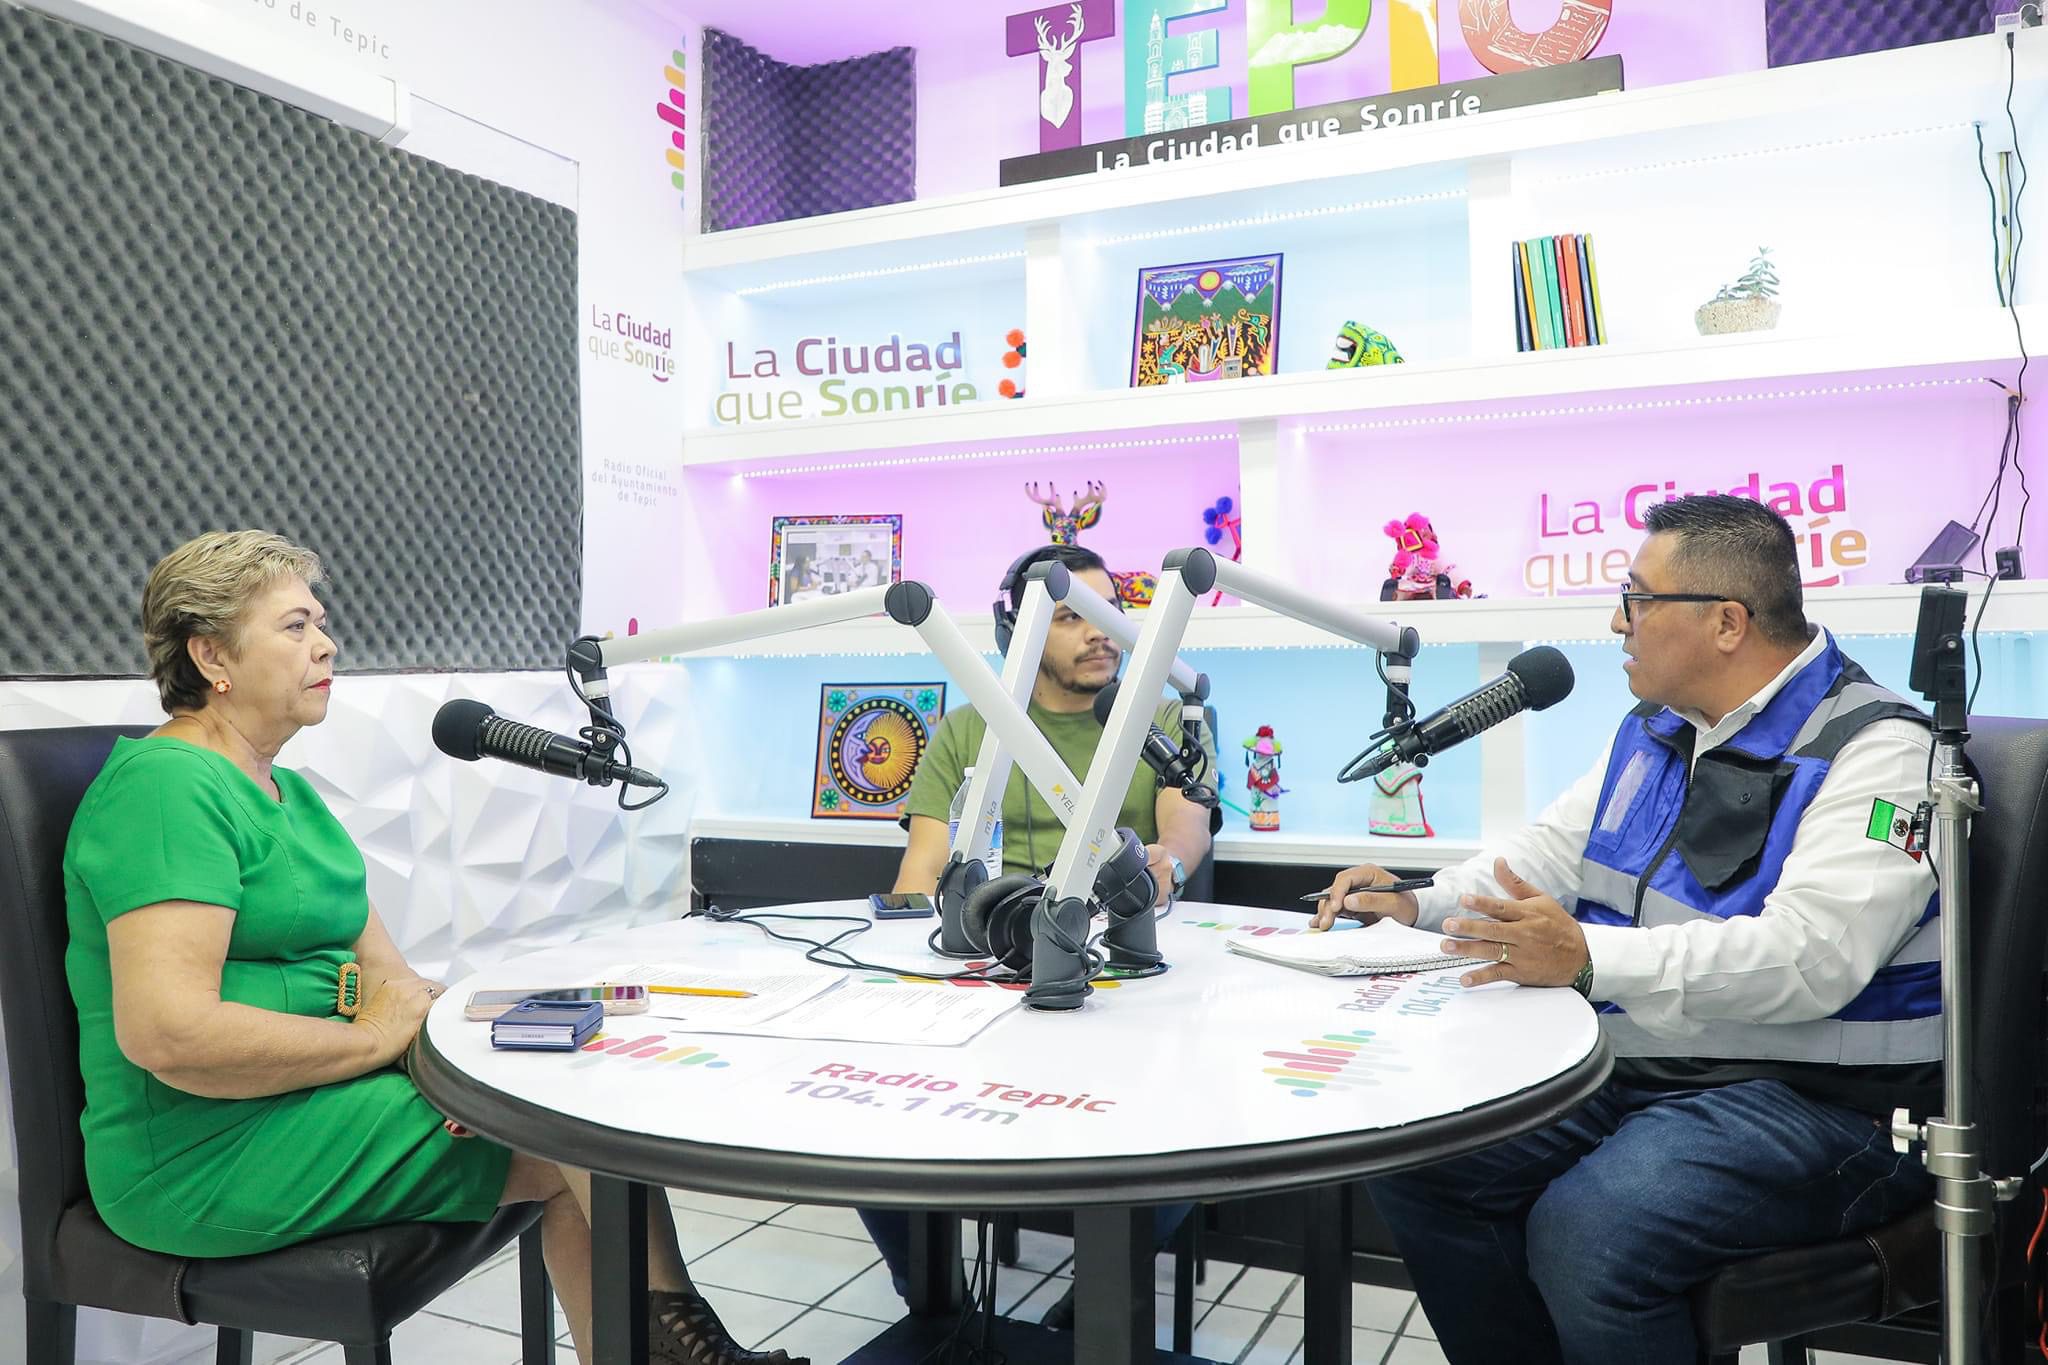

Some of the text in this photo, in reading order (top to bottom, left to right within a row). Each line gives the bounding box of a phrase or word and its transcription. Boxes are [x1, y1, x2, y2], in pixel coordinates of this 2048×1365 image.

[290, 1, 389, 59] de Tepic
[1096, 91, 1482, 172] La Ciudad que Sonríe
[593, 304, 671, 349] La Ciudad
[589, 336, 675, 375] que Sonríe
[728, 332, 962, 379] La Ciudad
[716, 372, 978, 424] que Sonríe
[592, 471, 678, 496] del Ayuntamiento
[603, 458, 667, 481] Radio Oficial
[617, 490, 629, 502] de
[1541, 464, 1846, 538] La Cad
[1525, 549, 1632, 597] que
[1086, 828, 1106, 868] mika
[1336, 984, 1400, 1013] Radio
[809, 1062, 1117, 1113] Radio Tepic
[939, 1101, 1020, 1125] fm
